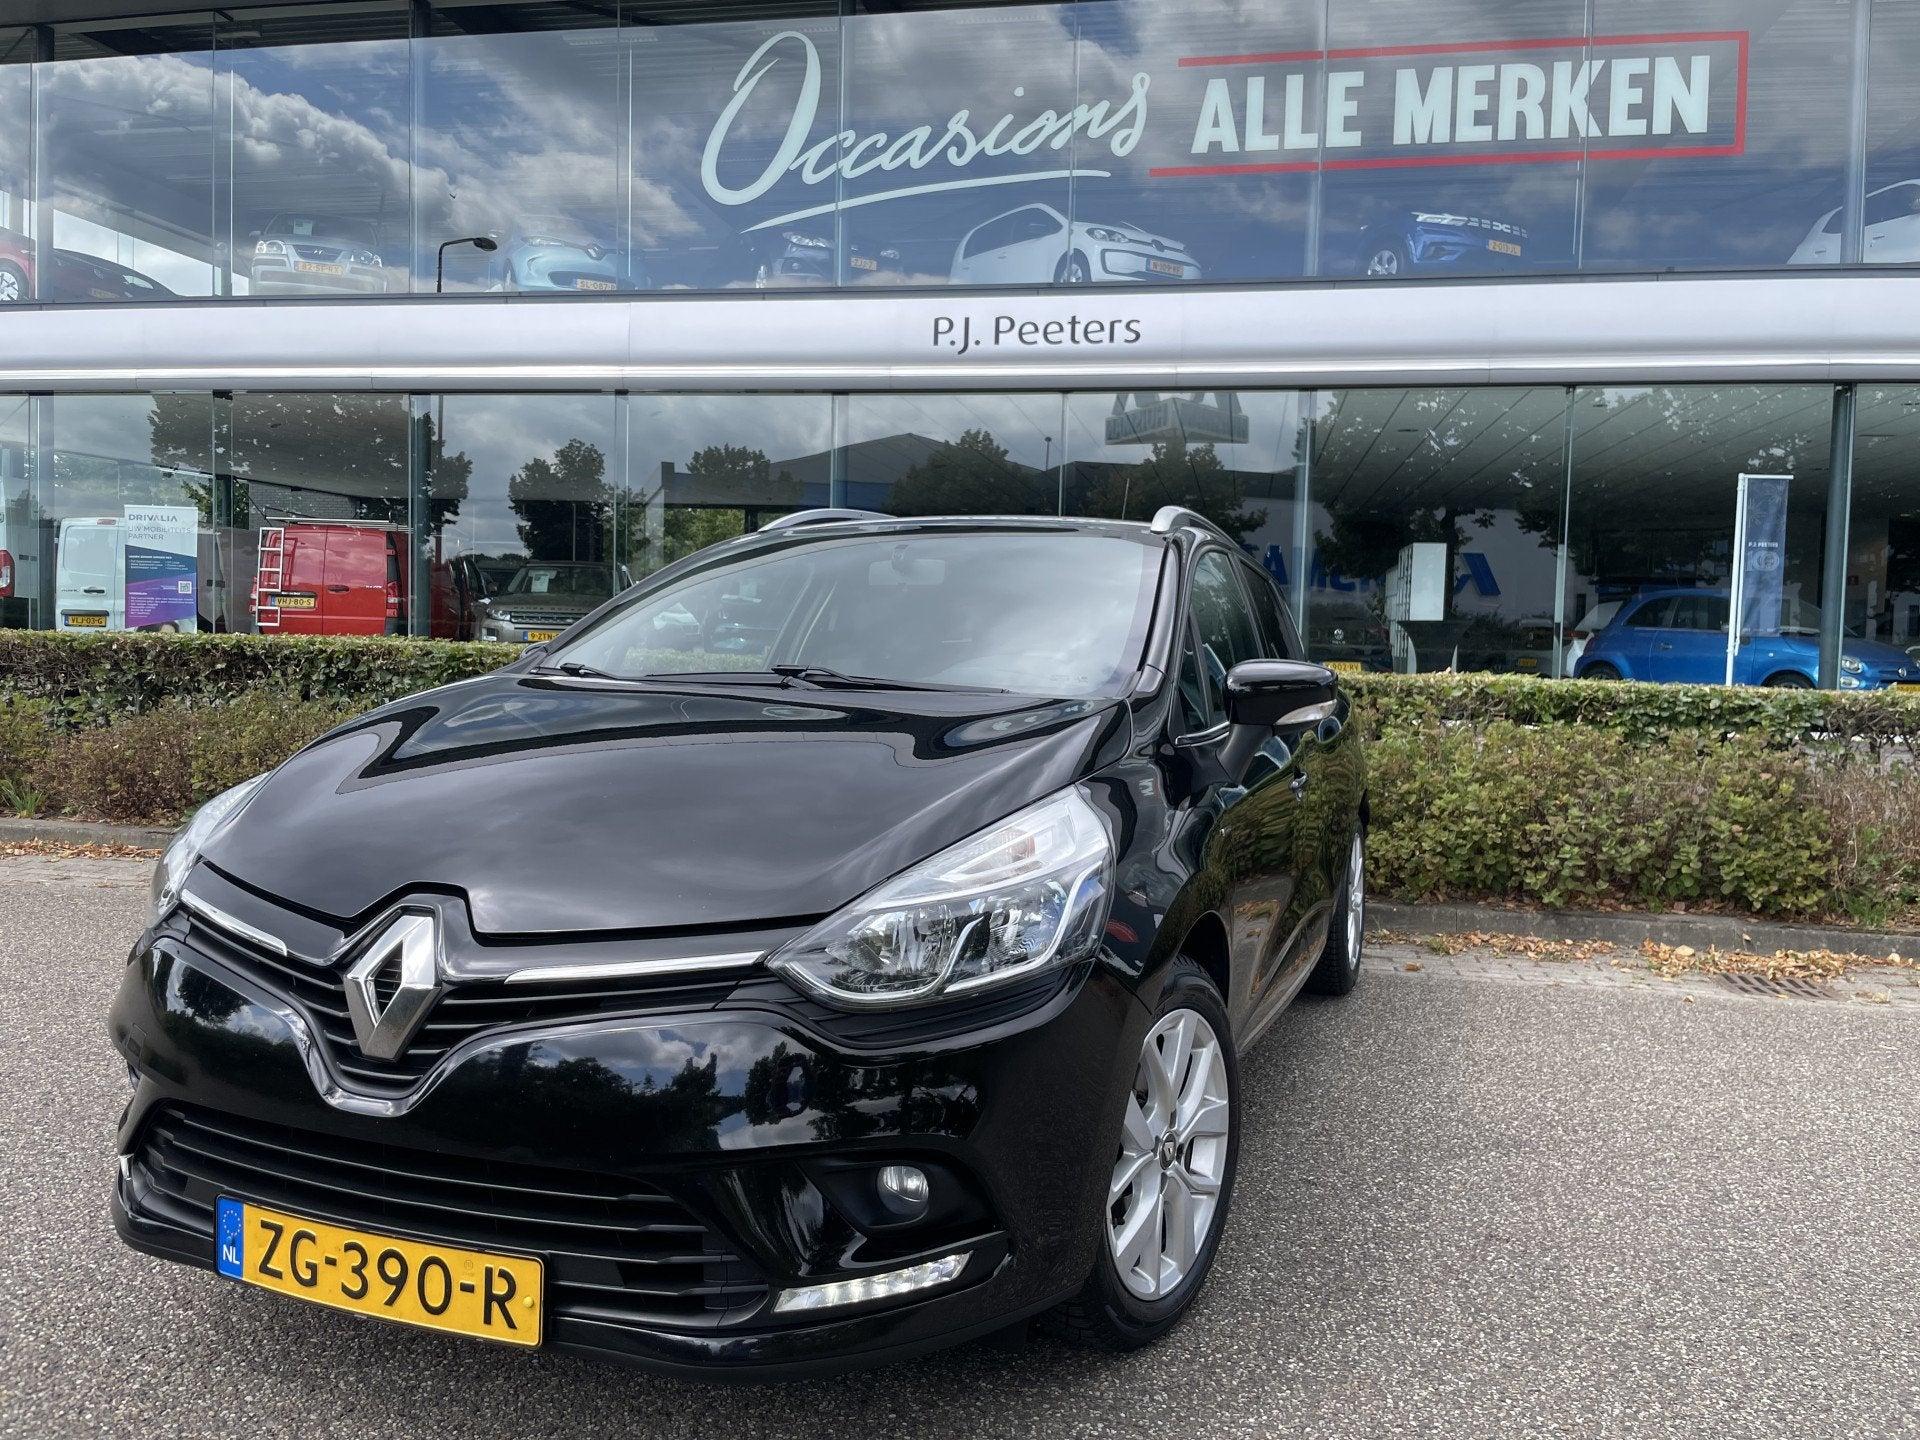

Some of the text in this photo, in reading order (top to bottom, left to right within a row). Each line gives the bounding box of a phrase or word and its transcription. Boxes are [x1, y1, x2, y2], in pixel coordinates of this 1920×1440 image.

[701, 30, 1151, 205] Occasions
[1191, 55, 1711, 154] ALLE MERKEN
[933, 315, 1141, 355] P.J. Peeters
[128, 513, 178, 522] DRIVALIA
[71, 617, 103, 625] VLJ-03-G
[222, 1243, 241, 1266] NL
[258, 1218, 518, 1330] ZG-390-R
